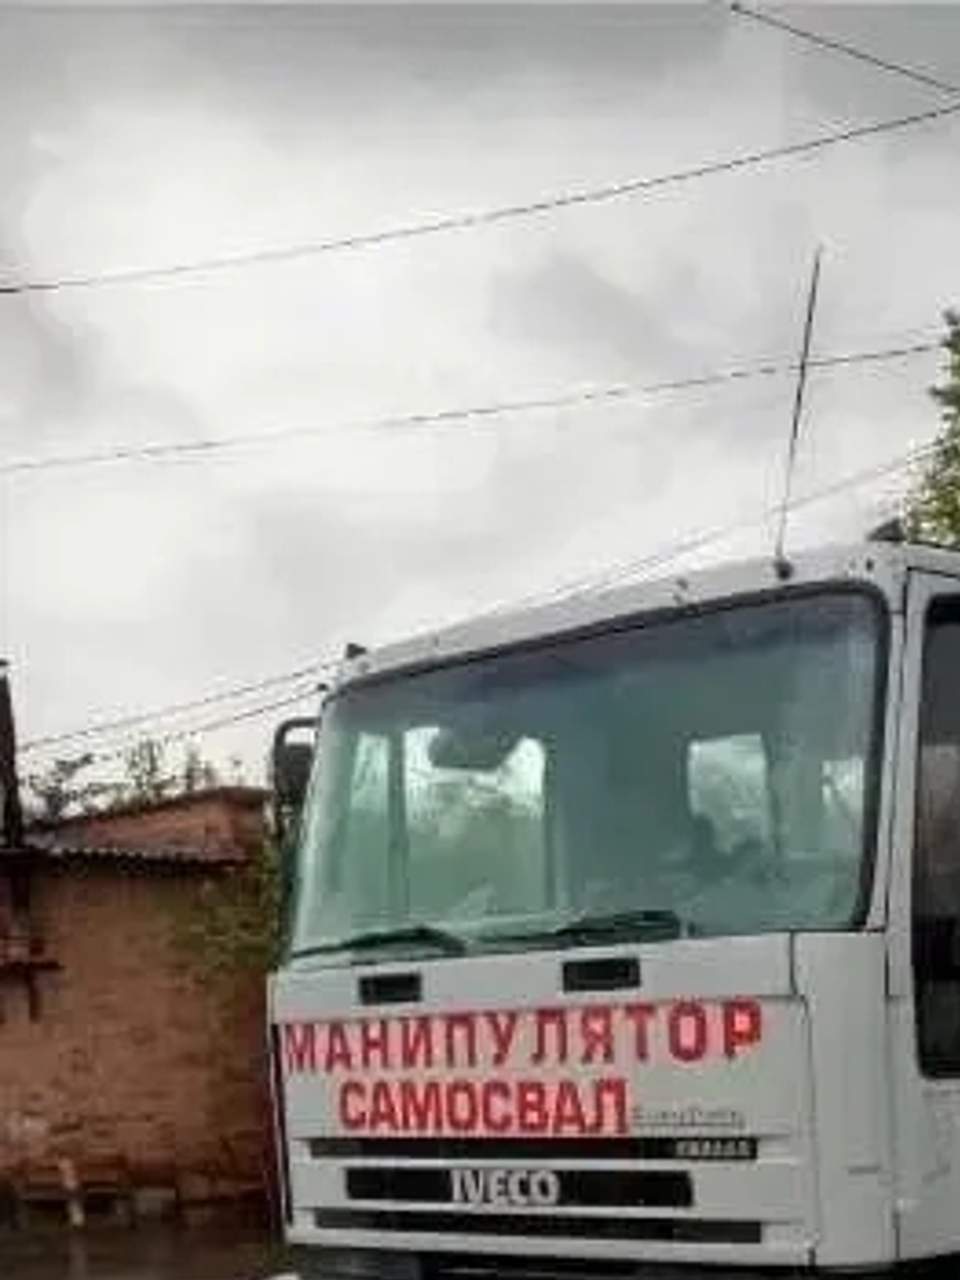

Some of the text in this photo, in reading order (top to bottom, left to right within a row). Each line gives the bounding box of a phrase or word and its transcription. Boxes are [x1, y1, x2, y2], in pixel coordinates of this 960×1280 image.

[283, 997, 763, 1073] МАНИПУЛЯТОР
[338, 1077, 631, 1136] САМОСВАЛ
[450, 1168, 561, 1206] IVECO
